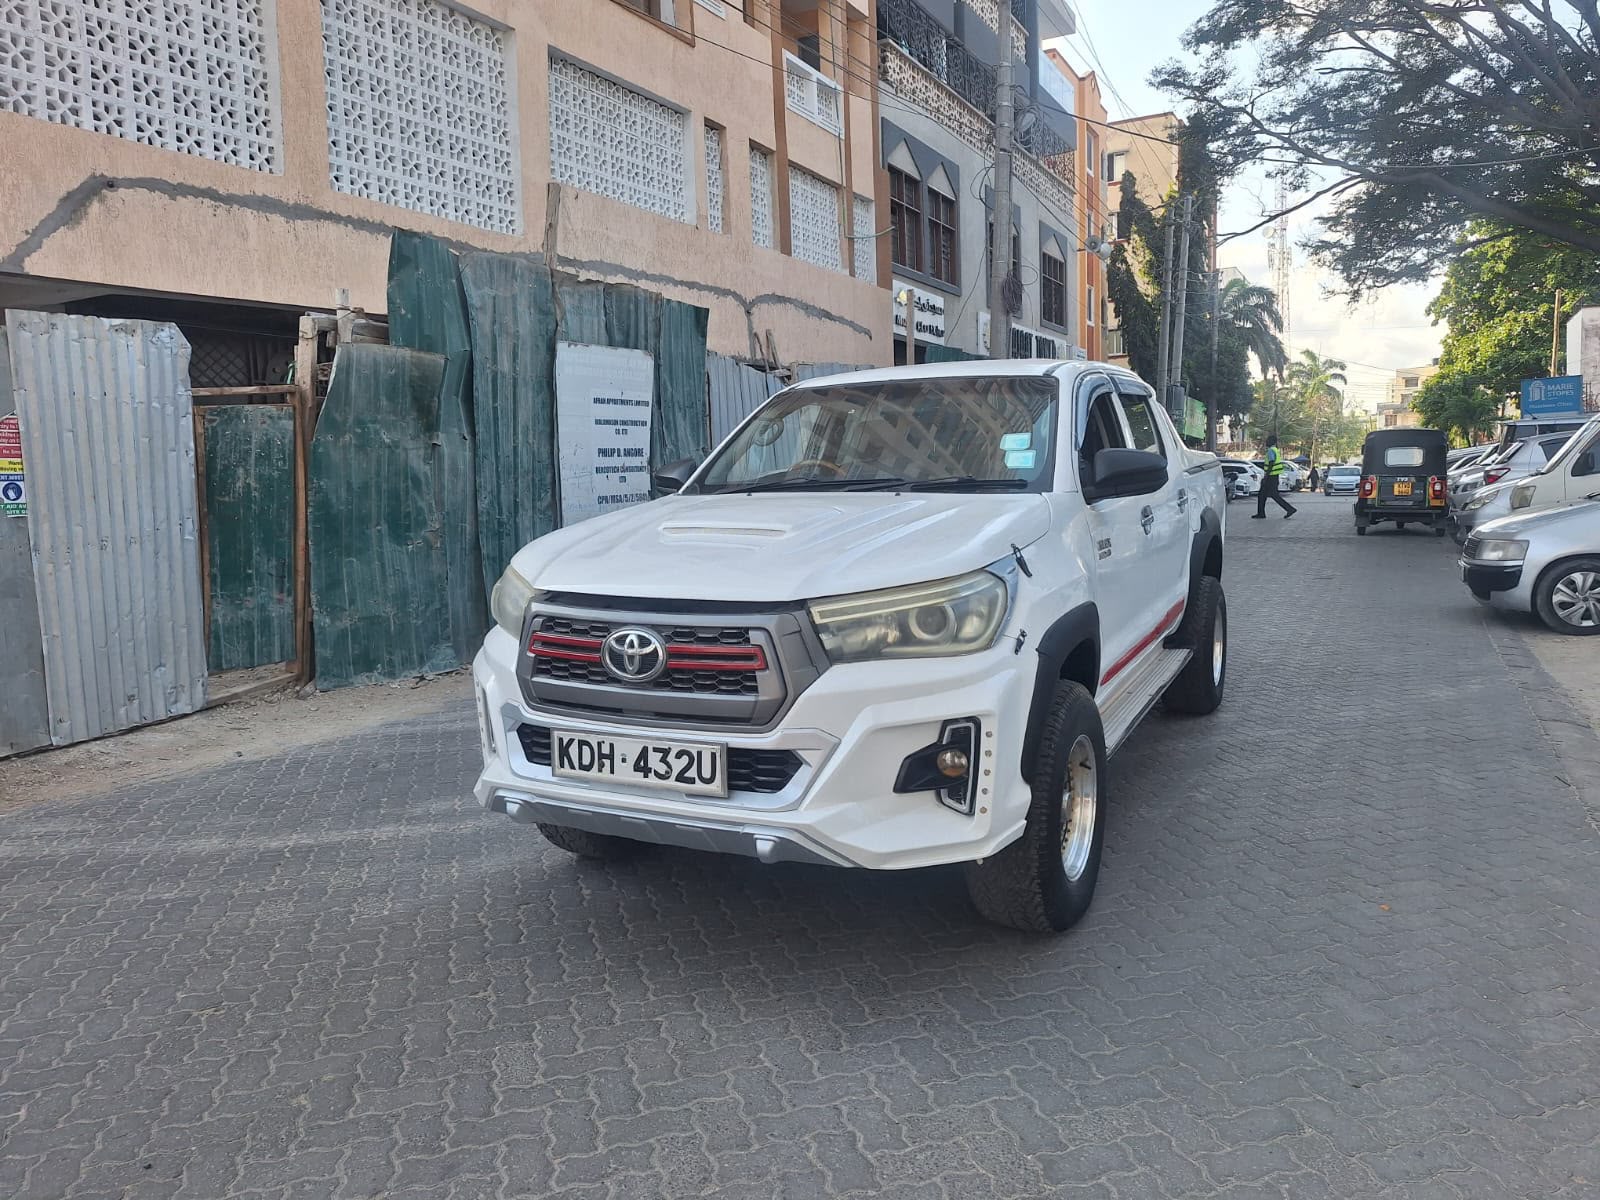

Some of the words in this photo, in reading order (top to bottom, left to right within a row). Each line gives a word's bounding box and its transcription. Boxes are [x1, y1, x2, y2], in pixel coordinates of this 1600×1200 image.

[597, 447, 616, 457] PHILIP
[558, 737, 615, 775] KDH
[633, 745, 717, 785] 432U
